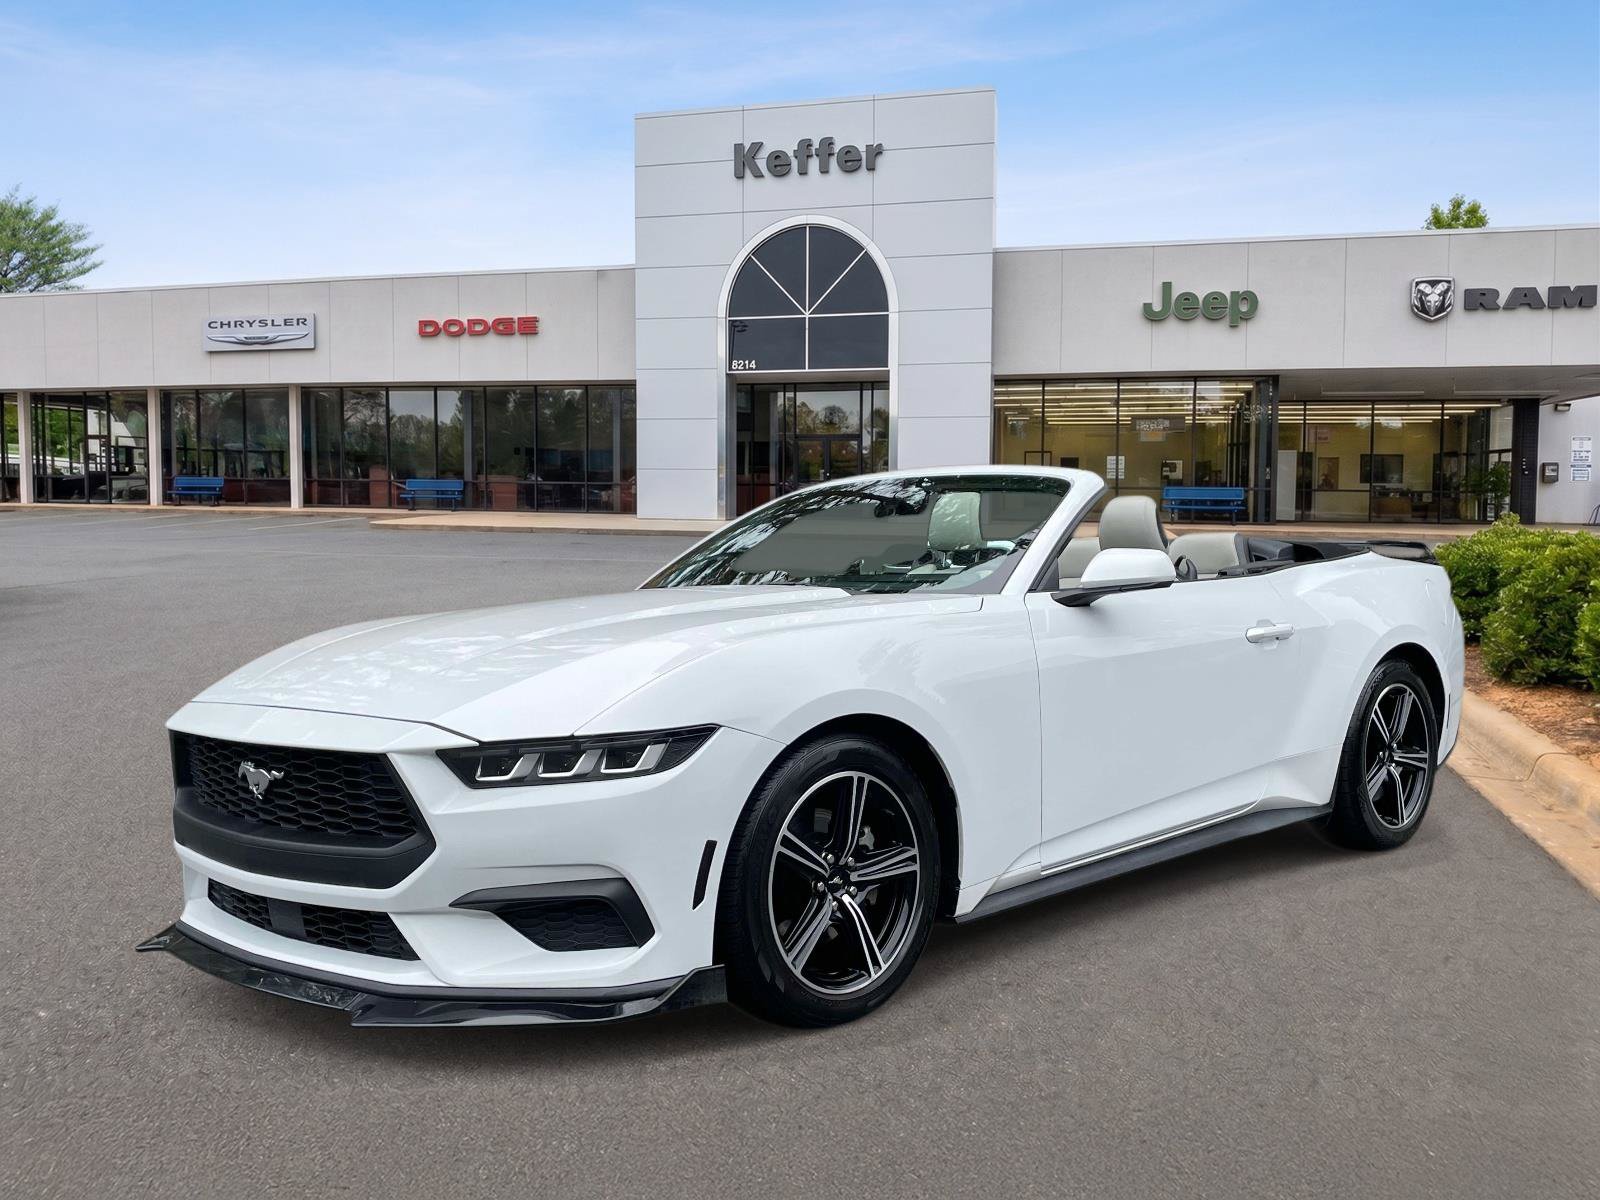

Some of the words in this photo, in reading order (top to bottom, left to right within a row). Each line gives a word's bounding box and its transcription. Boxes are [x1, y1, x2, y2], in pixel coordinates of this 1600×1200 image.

[734, 137, 883, 178] Keffer
[1143, 281, 1259, 327] Jeep
[1464, 285, 1598, 310] RAM
[207, 318, 308, 329] CHRYSLER
[418, 316, 538, 337] DODGE
[731, 360, 756, 370] 8214
